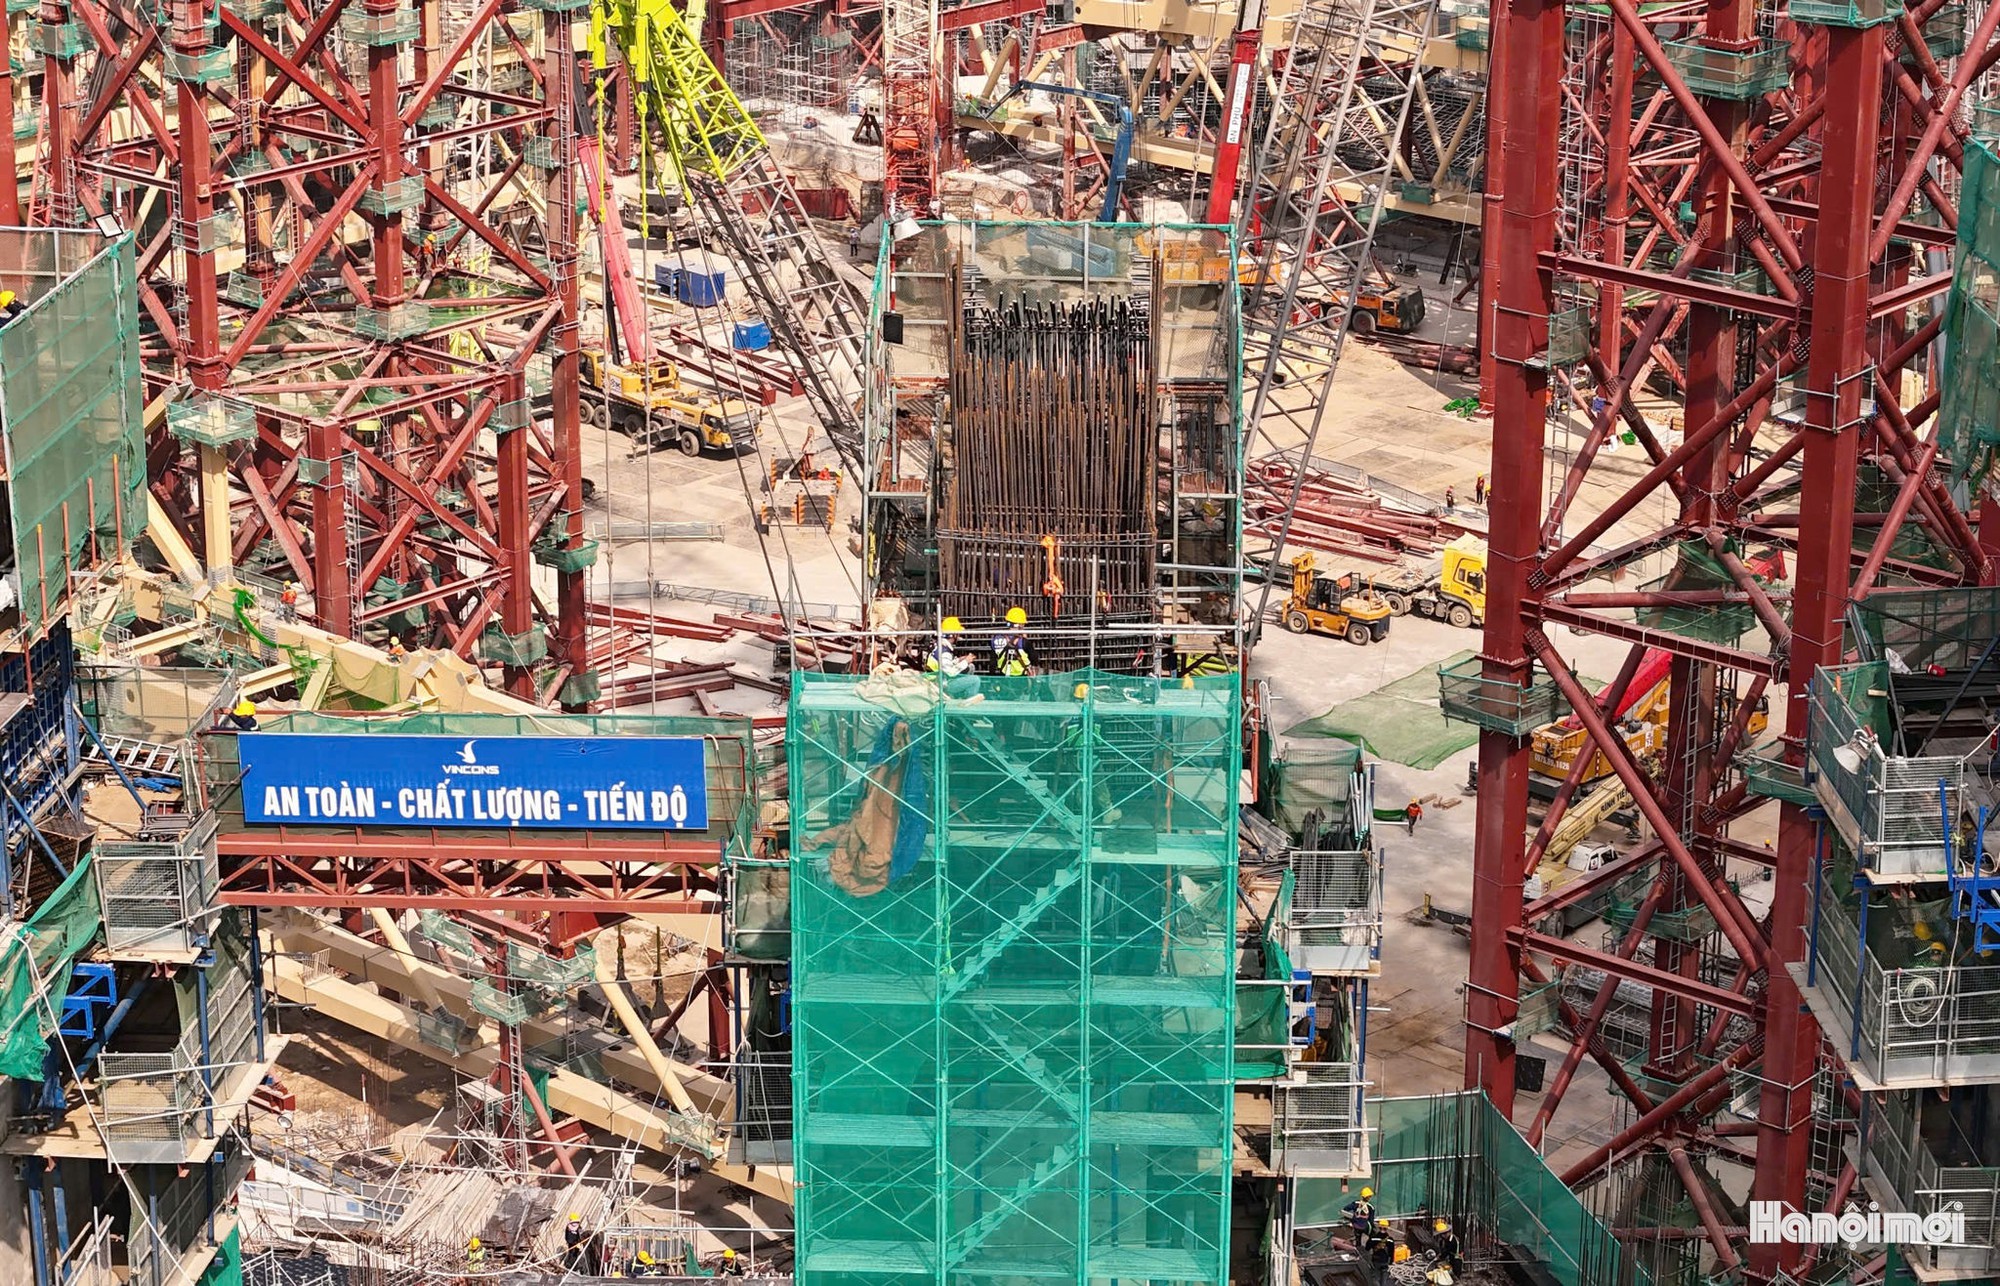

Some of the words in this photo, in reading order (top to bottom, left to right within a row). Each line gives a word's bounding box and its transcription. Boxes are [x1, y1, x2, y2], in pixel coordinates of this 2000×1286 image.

[442, 765, 500, 775] VINCONS
[263, 786, 299, 816] AN
[304, 780, 375, 818] TOÀN
[381, 801, 392, 809] -
[398, 778, 466, 819] CHẤT
[472, 786, 561, 827] LƯỢNG
[567, 803, 578, 812] -
[583, 781, 645, 822] TIẾN
[650, 784, 688, 830] ĐỘ
